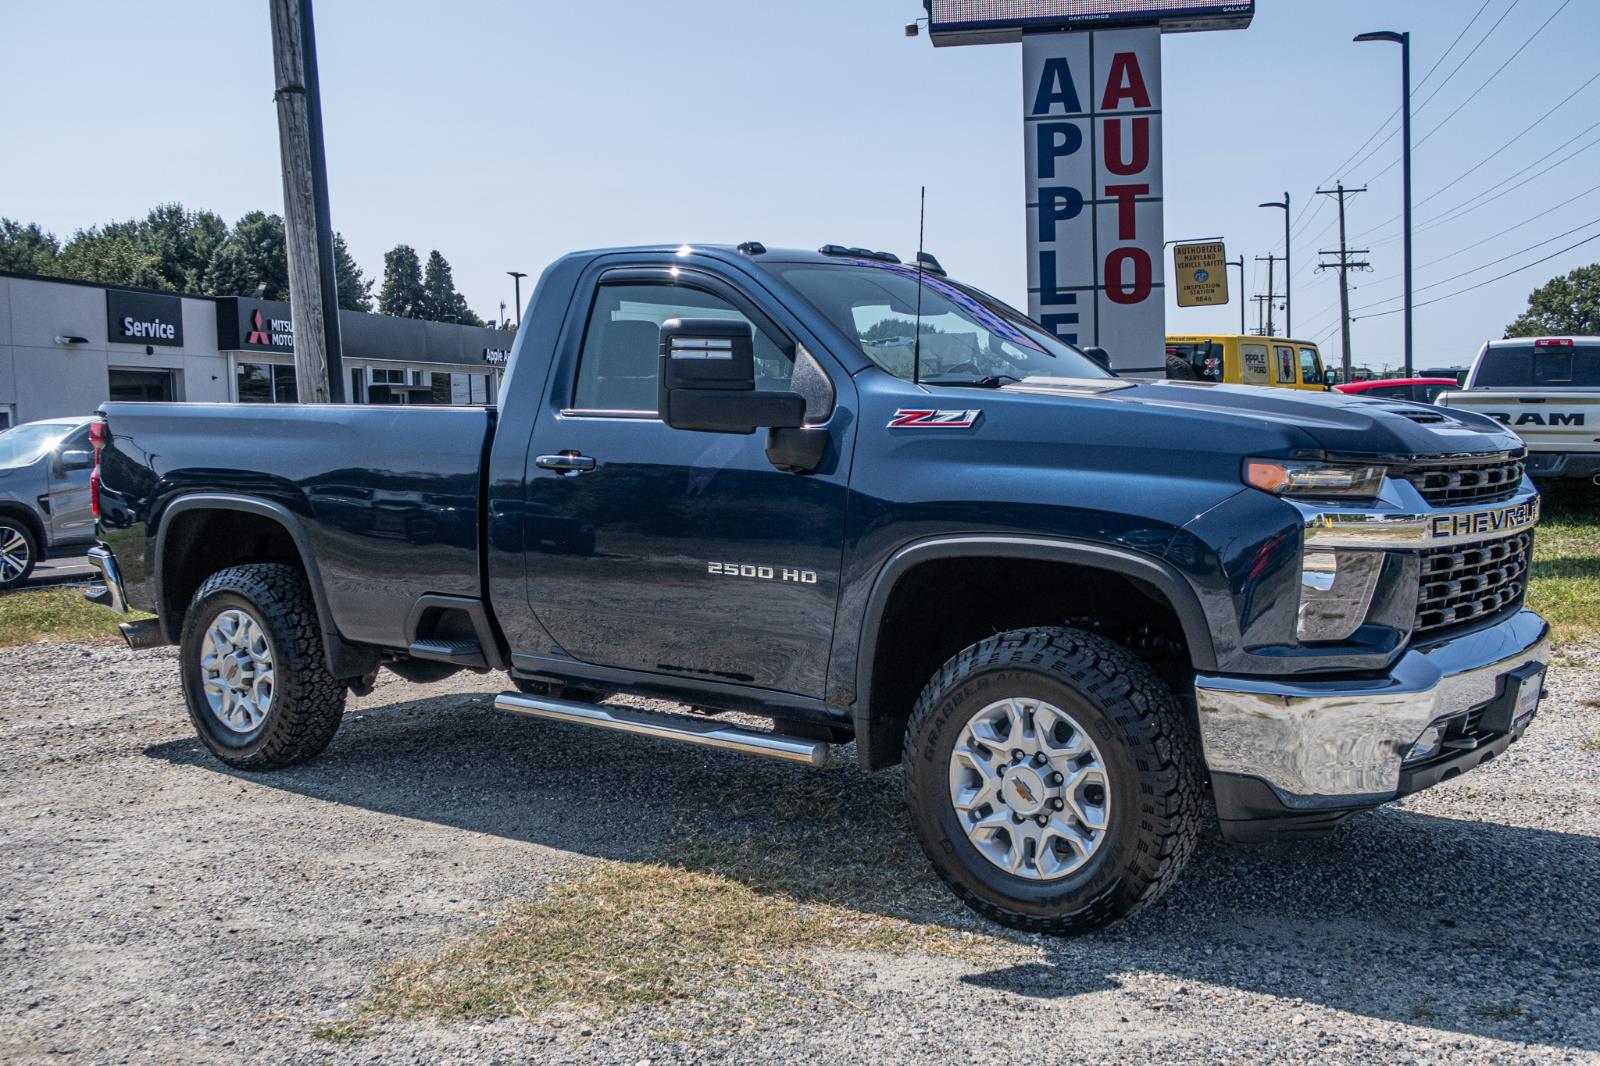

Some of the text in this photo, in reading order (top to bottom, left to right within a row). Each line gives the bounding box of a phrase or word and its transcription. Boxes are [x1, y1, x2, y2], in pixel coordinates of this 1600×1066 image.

[1101, 52, 1152, 304] AUTO
[1032, 57, 1083, 345] APPLE
[1177, 245, 1223, 255] AUTHORIZED
[1184, 254, 1216, 262] MARYLAND
[1177, 260, 1223, 269] VEHICLE SAFETY
[124, 317, 175, 339] Service
[486, 348, 503, 364] Apple
[1245, 354, 1265, 364] APPLE
[886, 408, 981, 428] Z71
[1483, 413, 1585, 426] RAM
[708, 561, 817, 584] 2500 HD
